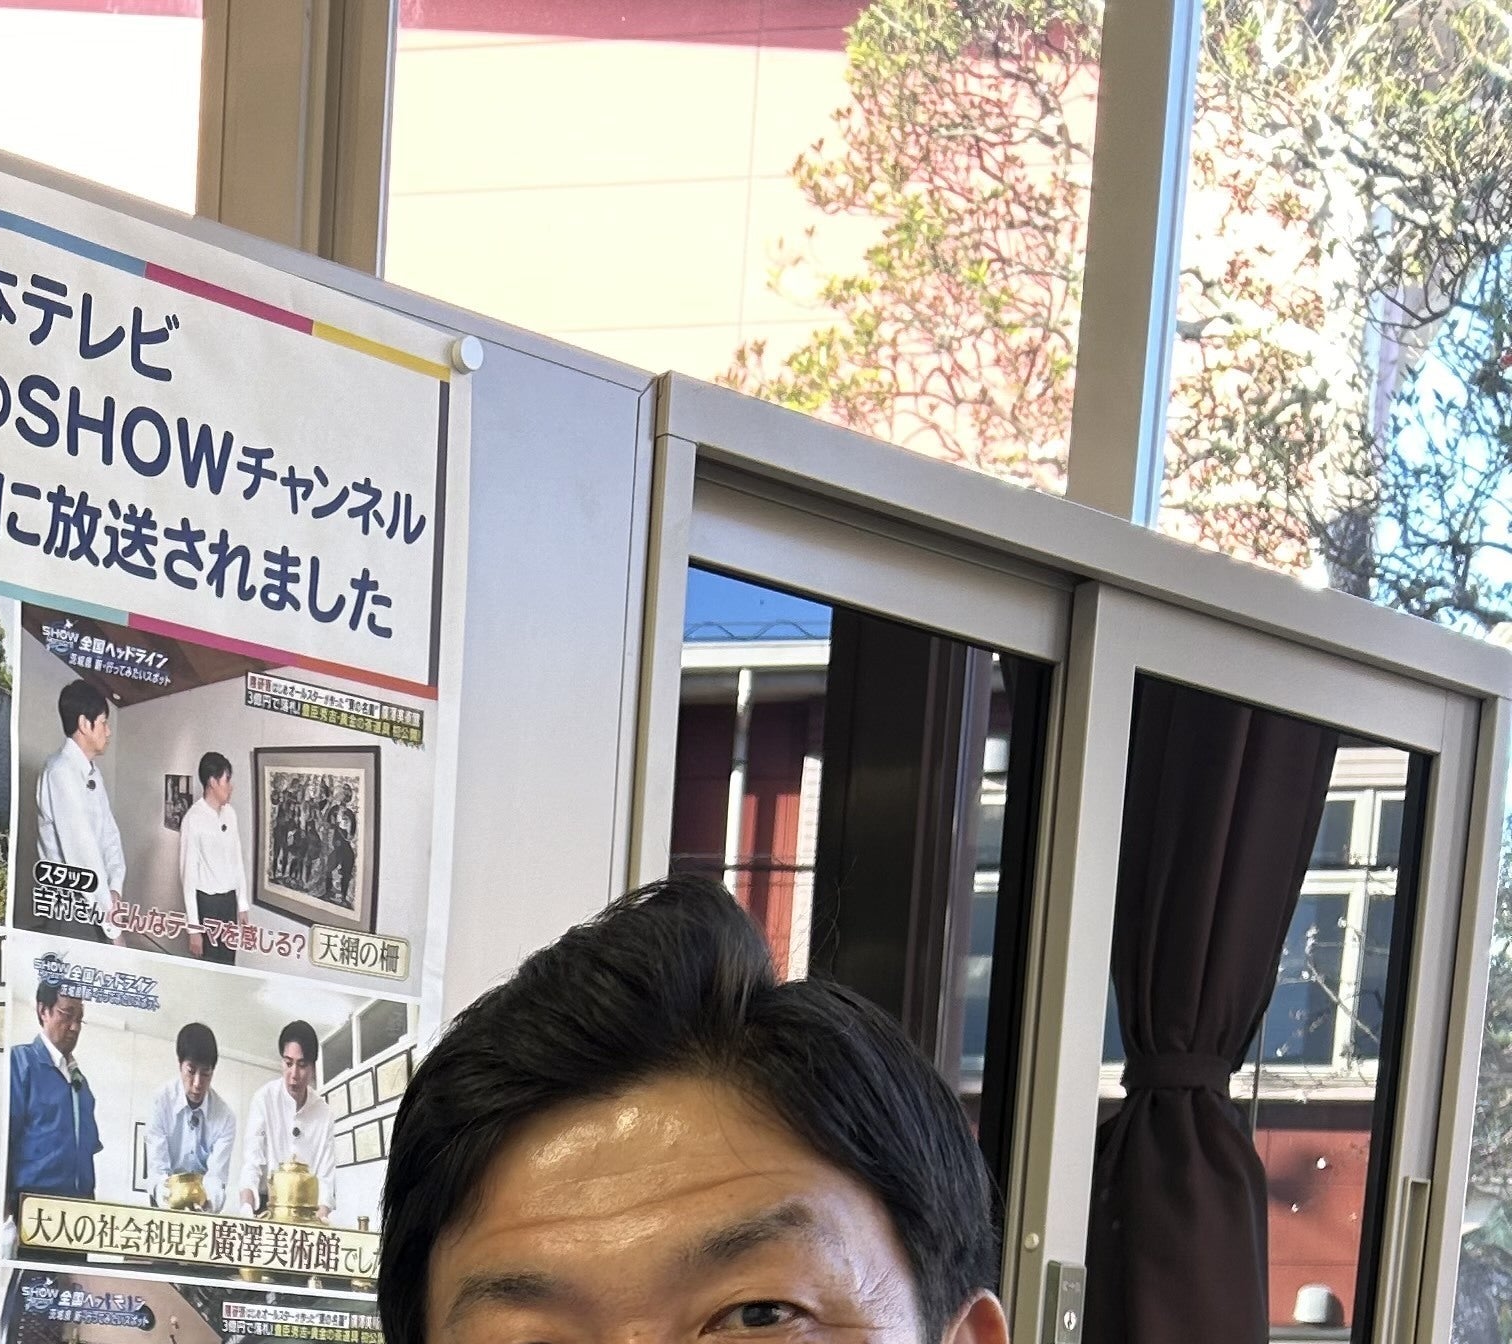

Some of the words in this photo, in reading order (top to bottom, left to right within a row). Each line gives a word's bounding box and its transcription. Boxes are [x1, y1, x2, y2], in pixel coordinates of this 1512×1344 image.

[79, 636, 168, 669] 全国ヘッドライン
[39, 864, 94, 889] スタッフ
[33, 886, 105, 925] 吉村さん
[28, 1208, 208, 1257] 大人の社会科見学
